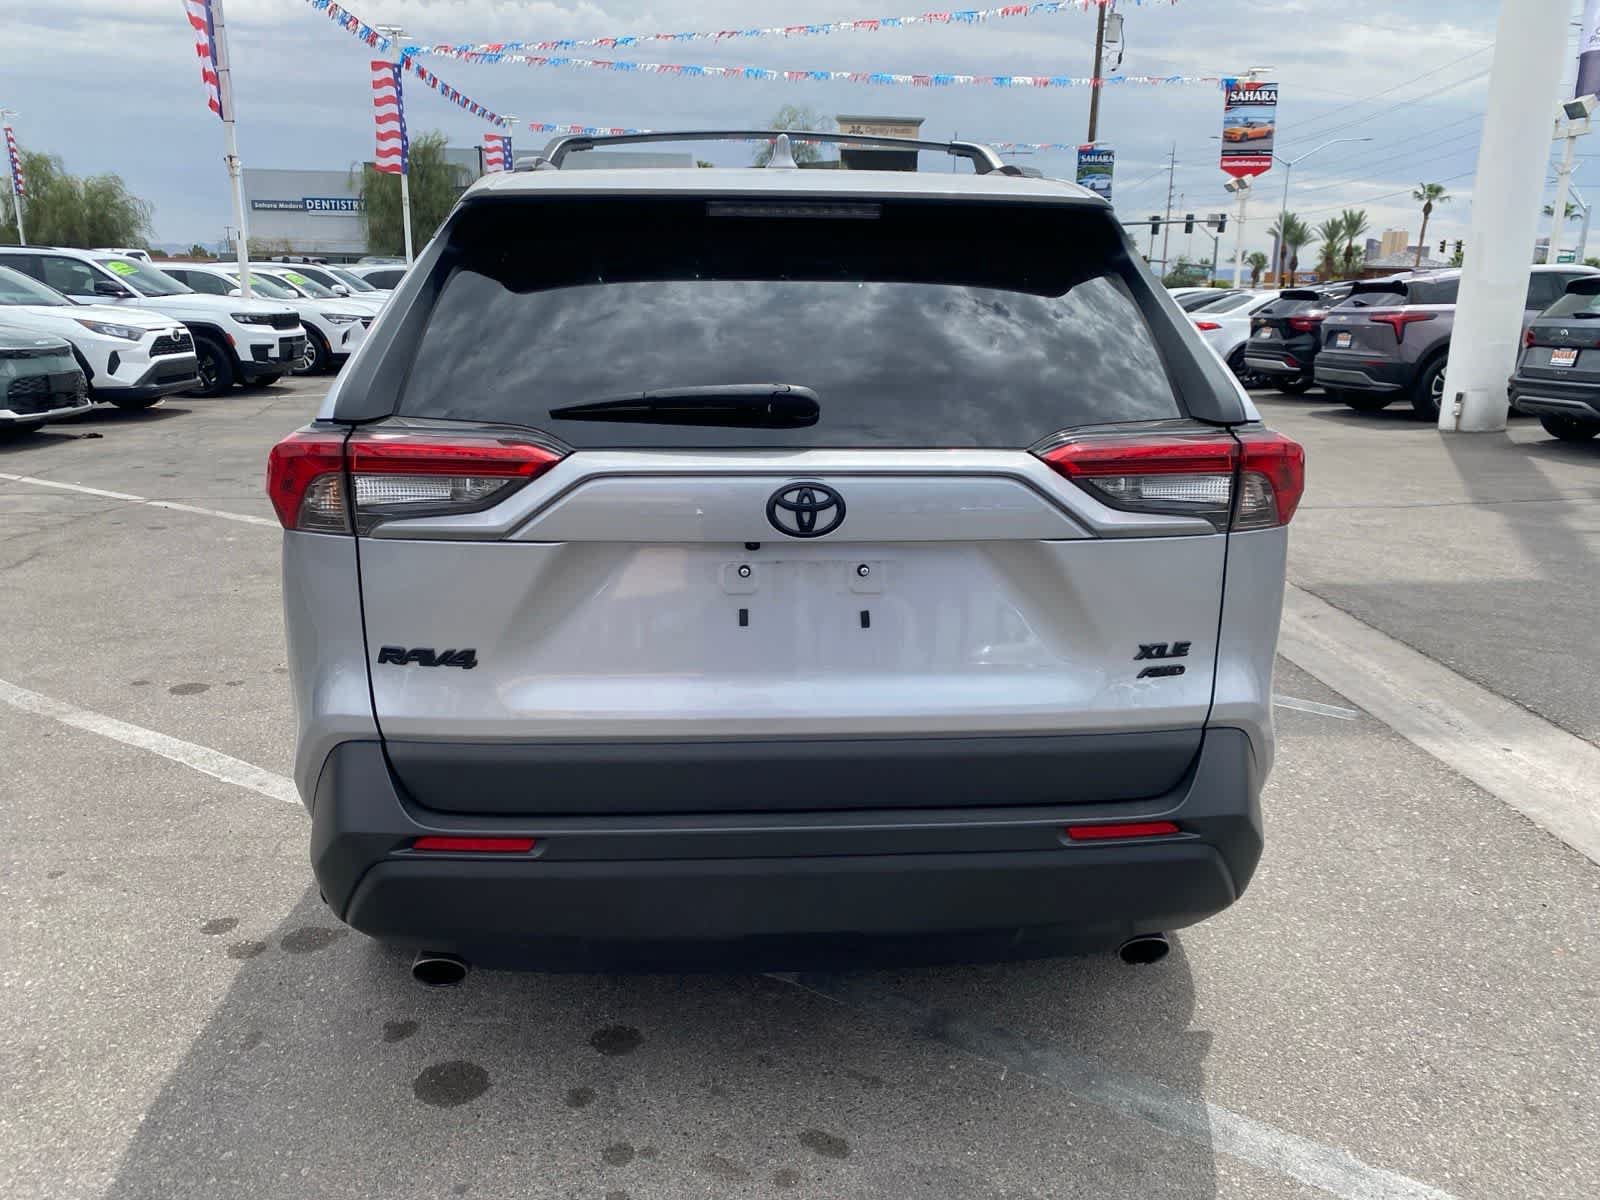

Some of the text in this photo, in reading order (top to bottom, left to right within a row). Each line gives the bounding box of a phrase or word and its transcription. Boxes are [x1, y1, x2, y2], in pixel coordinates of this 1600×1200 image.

[1229, 90, 1277, 101] SAHARA
[1081, 153, 1114, 162] SAHARA
[305, 199, 365, 210] DENTISTRY
[1133, 640, 1191, 660] XLE
[377, 646, 478, 670] RAV4
[1136, 664, 1185, 679] AWD
